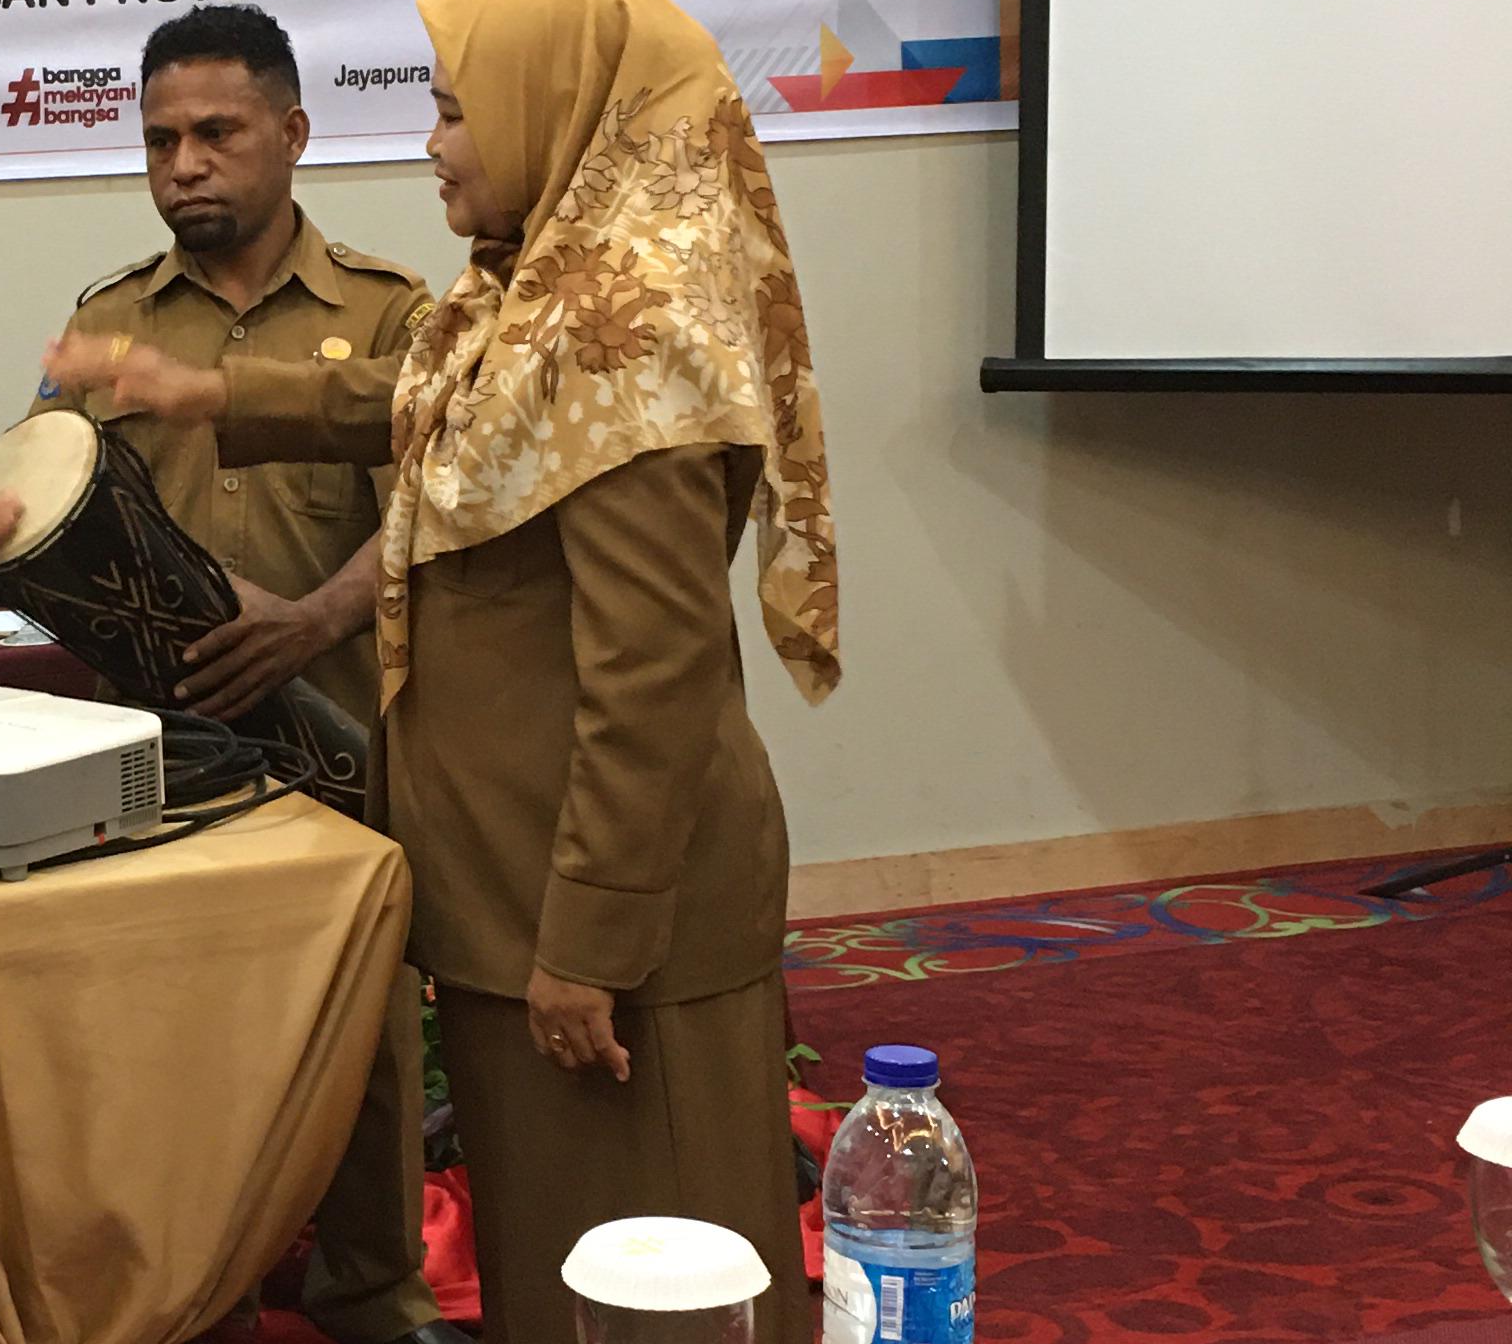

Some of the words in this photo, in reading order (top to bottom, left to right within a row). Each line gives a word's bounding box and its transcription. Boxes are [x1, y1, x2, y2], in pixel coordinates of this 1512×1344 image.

[42, 66, 122, 88] bangga
[333, 63, 430, 92] Jayapura
[43, 82, 137, 107] melayani
[43, 107, 120, 129] bangsa
